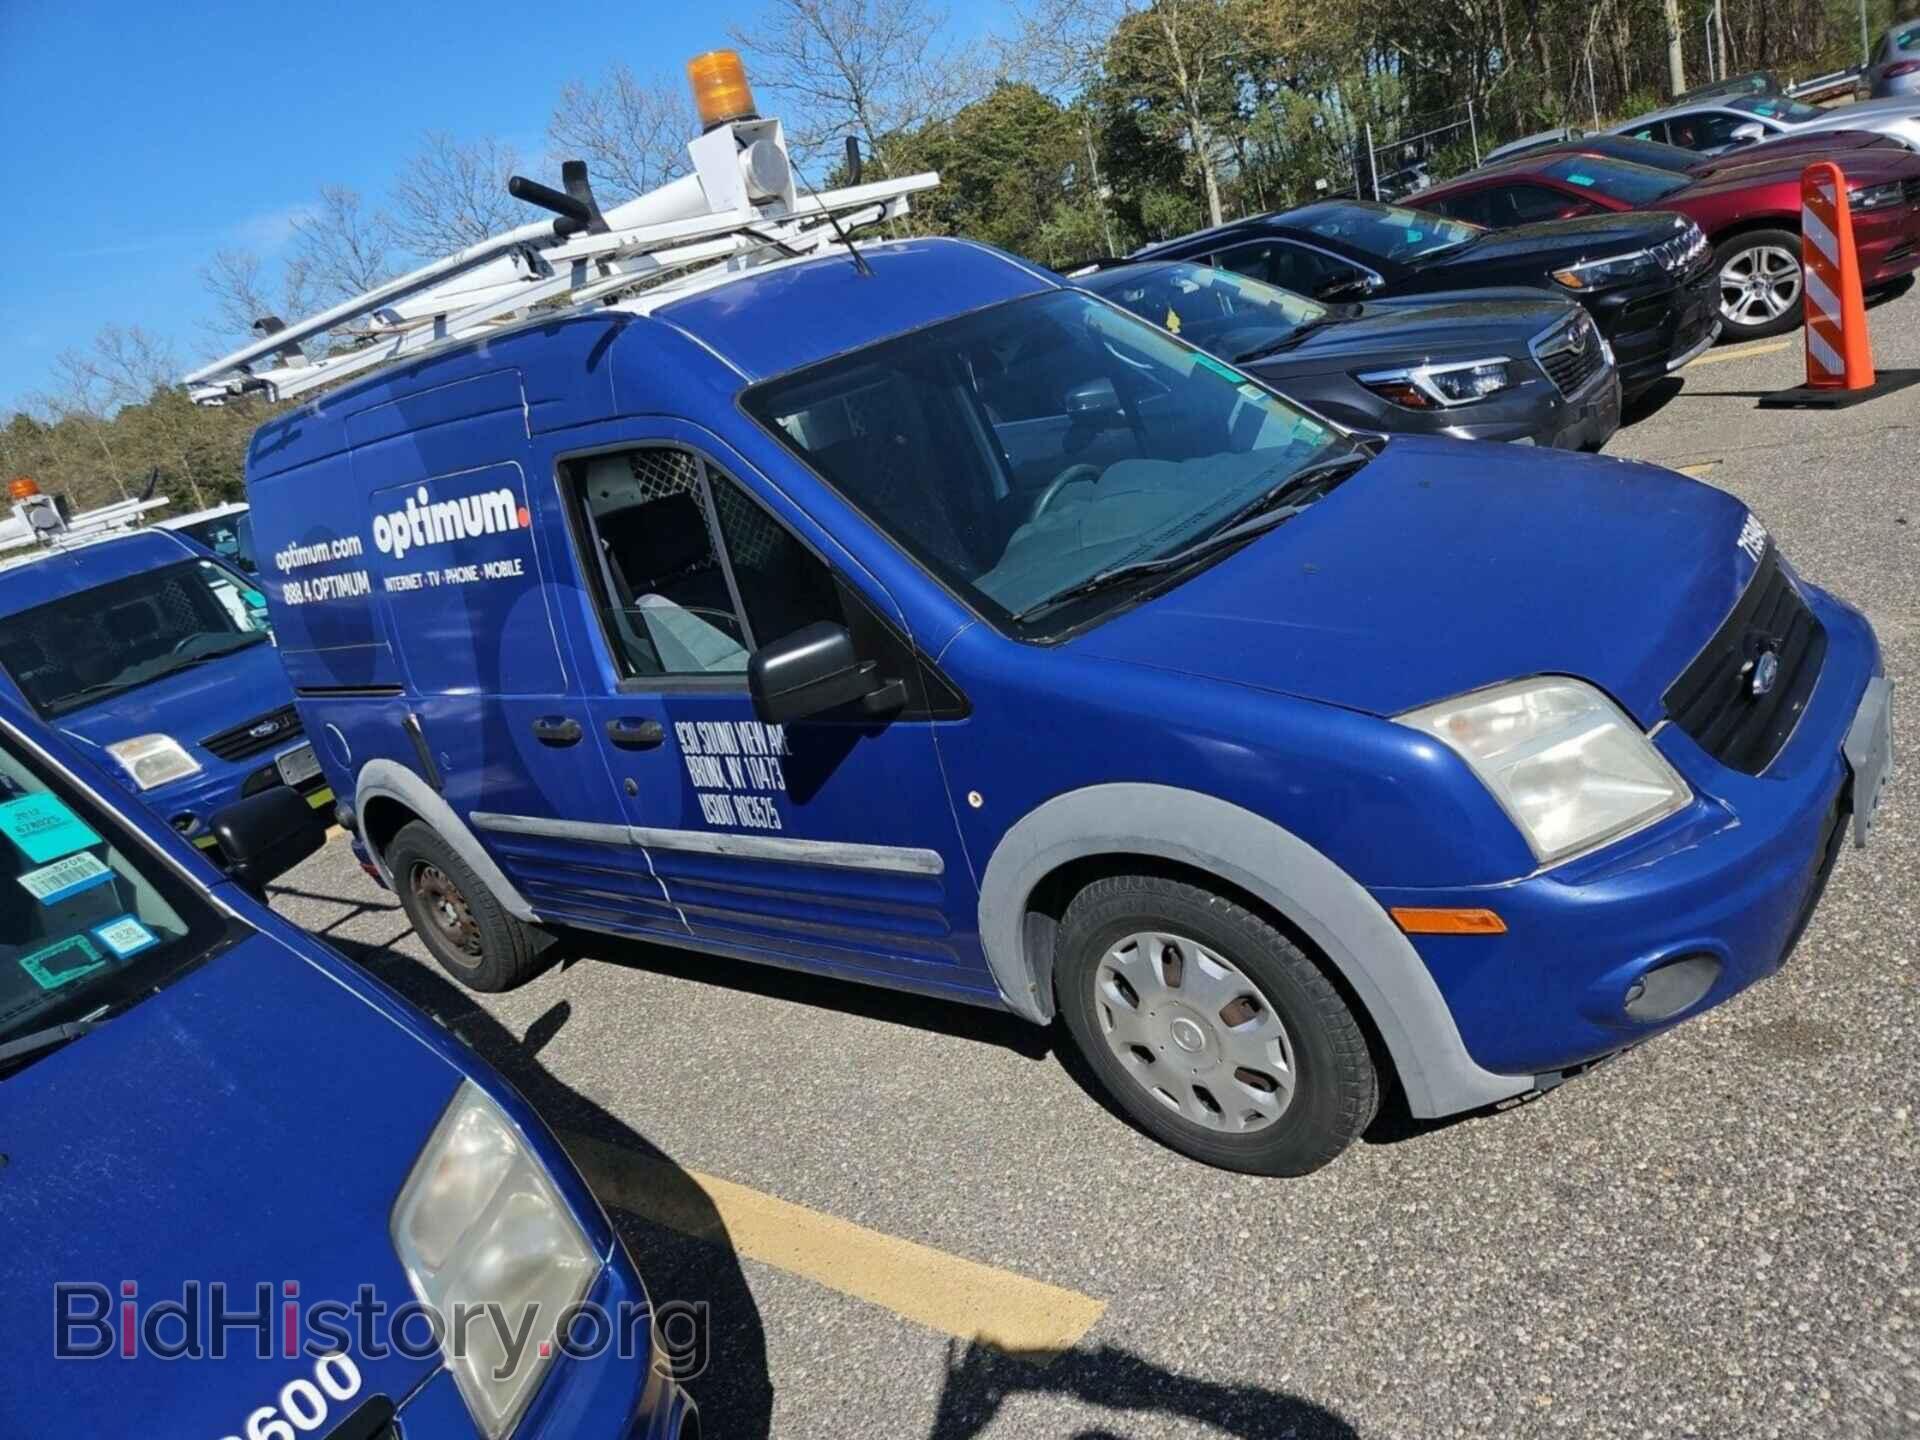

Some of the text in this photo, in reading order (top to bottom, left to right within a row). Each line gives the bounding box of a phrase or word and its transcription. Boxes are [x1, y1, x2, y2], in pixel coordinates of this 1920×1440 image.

[275, 536, 363, 575] optimum.com
[384, 558, 524, 592] INTERNET TV PHONE MOBILE
[696, 721, 740, 755] SOUND
[734, 721, 769, 756] VIEW
[684, 755, 786, 791] BRONX, NY 10473
[697, 793, 782, 830] USDOT 803525
[219, 1351, 363, 1440] 600
